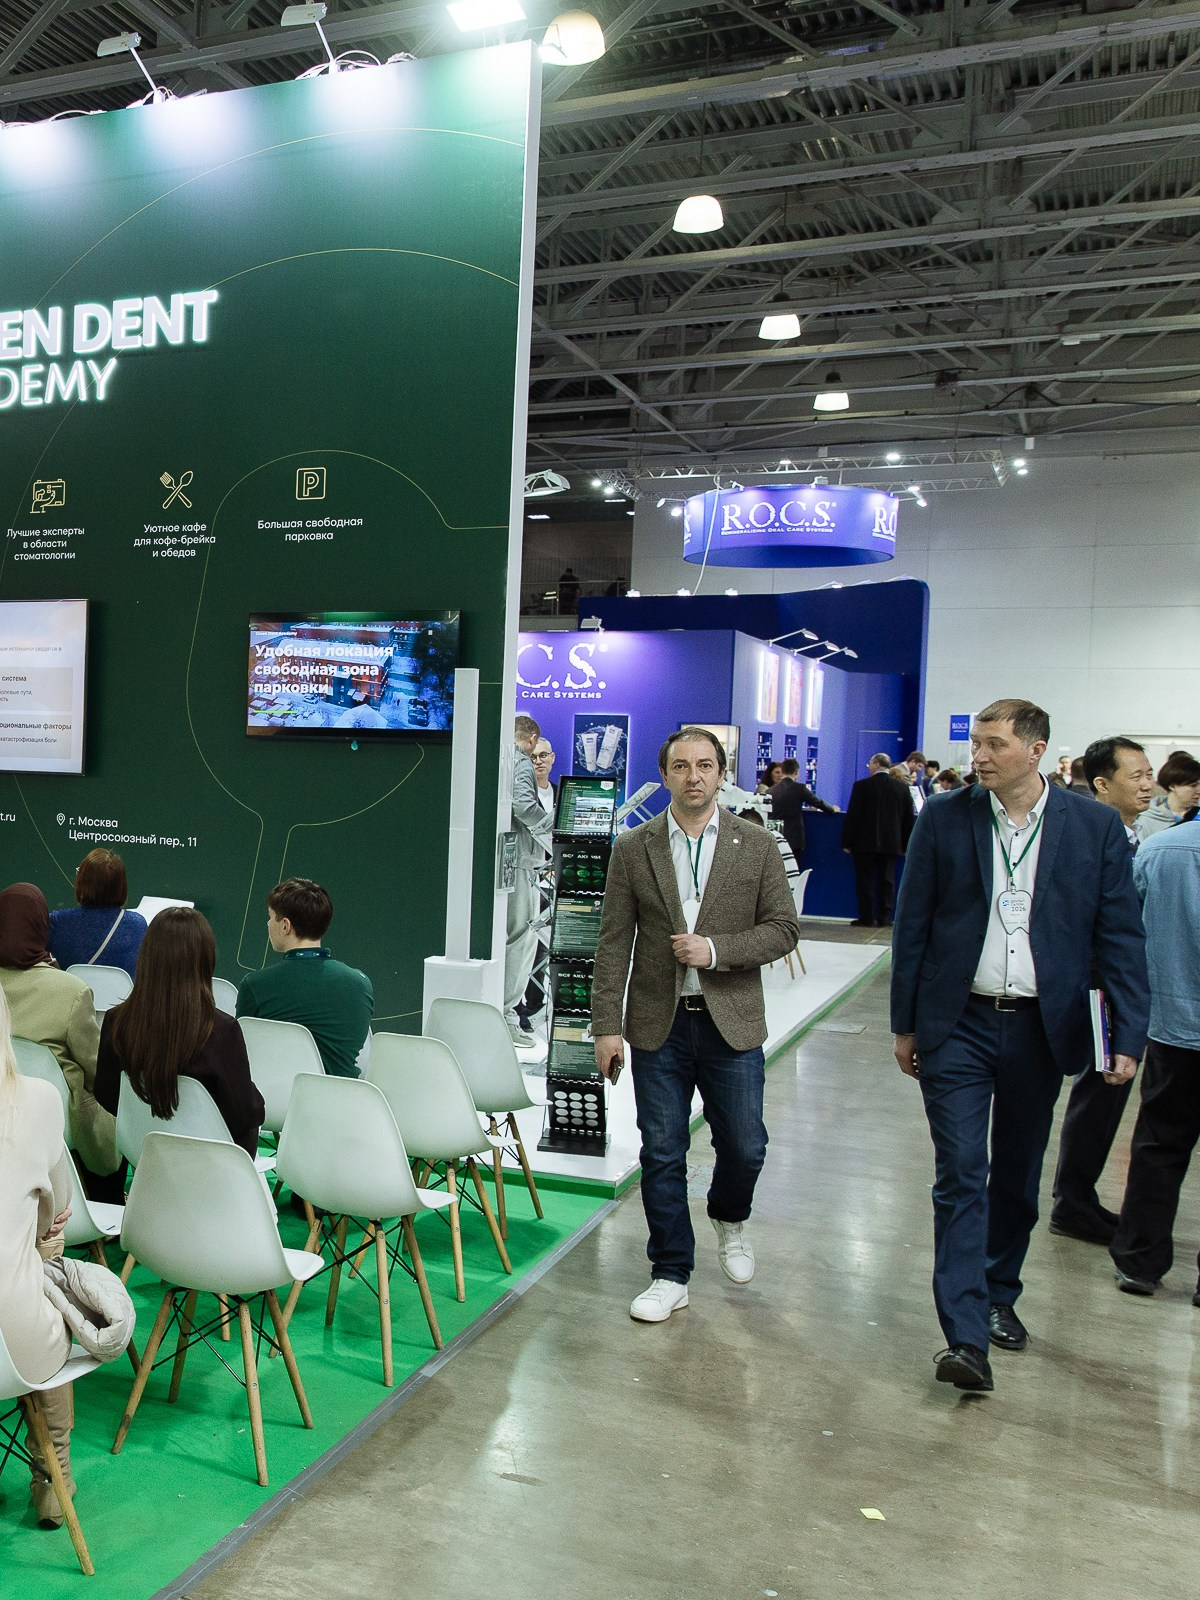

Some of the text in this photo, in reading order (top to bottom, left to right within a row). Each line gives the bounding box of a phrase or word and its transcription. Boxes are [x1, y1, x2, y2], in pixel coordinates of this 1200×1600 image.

[72, 289, 219, 354] DENT
[721, 501, 836, 531] R.O.C.S.
[143, 522, 207, 534] Уютное кафе
[257, 517, 363, 530] Большая свободная
[6, 526, 85, 538] Лучшие эксперты
[285, 531, 334, 542] парковка
[30, 538, 68, 548] области
[133, 534, 216, 547] для кофе-брейка
[14, 551, 76, 560] стоматологии
[160, 548, 196, 559] обедов
[254, 644, 394, 658] Удобная локация
[254, 664, 379, 678] свободная зона
[254, 682, 328, 696] парковки
[69, 816, 118, 828] г. Москва
[69, 829, 197, 848] Центросоюзный пер., 11
